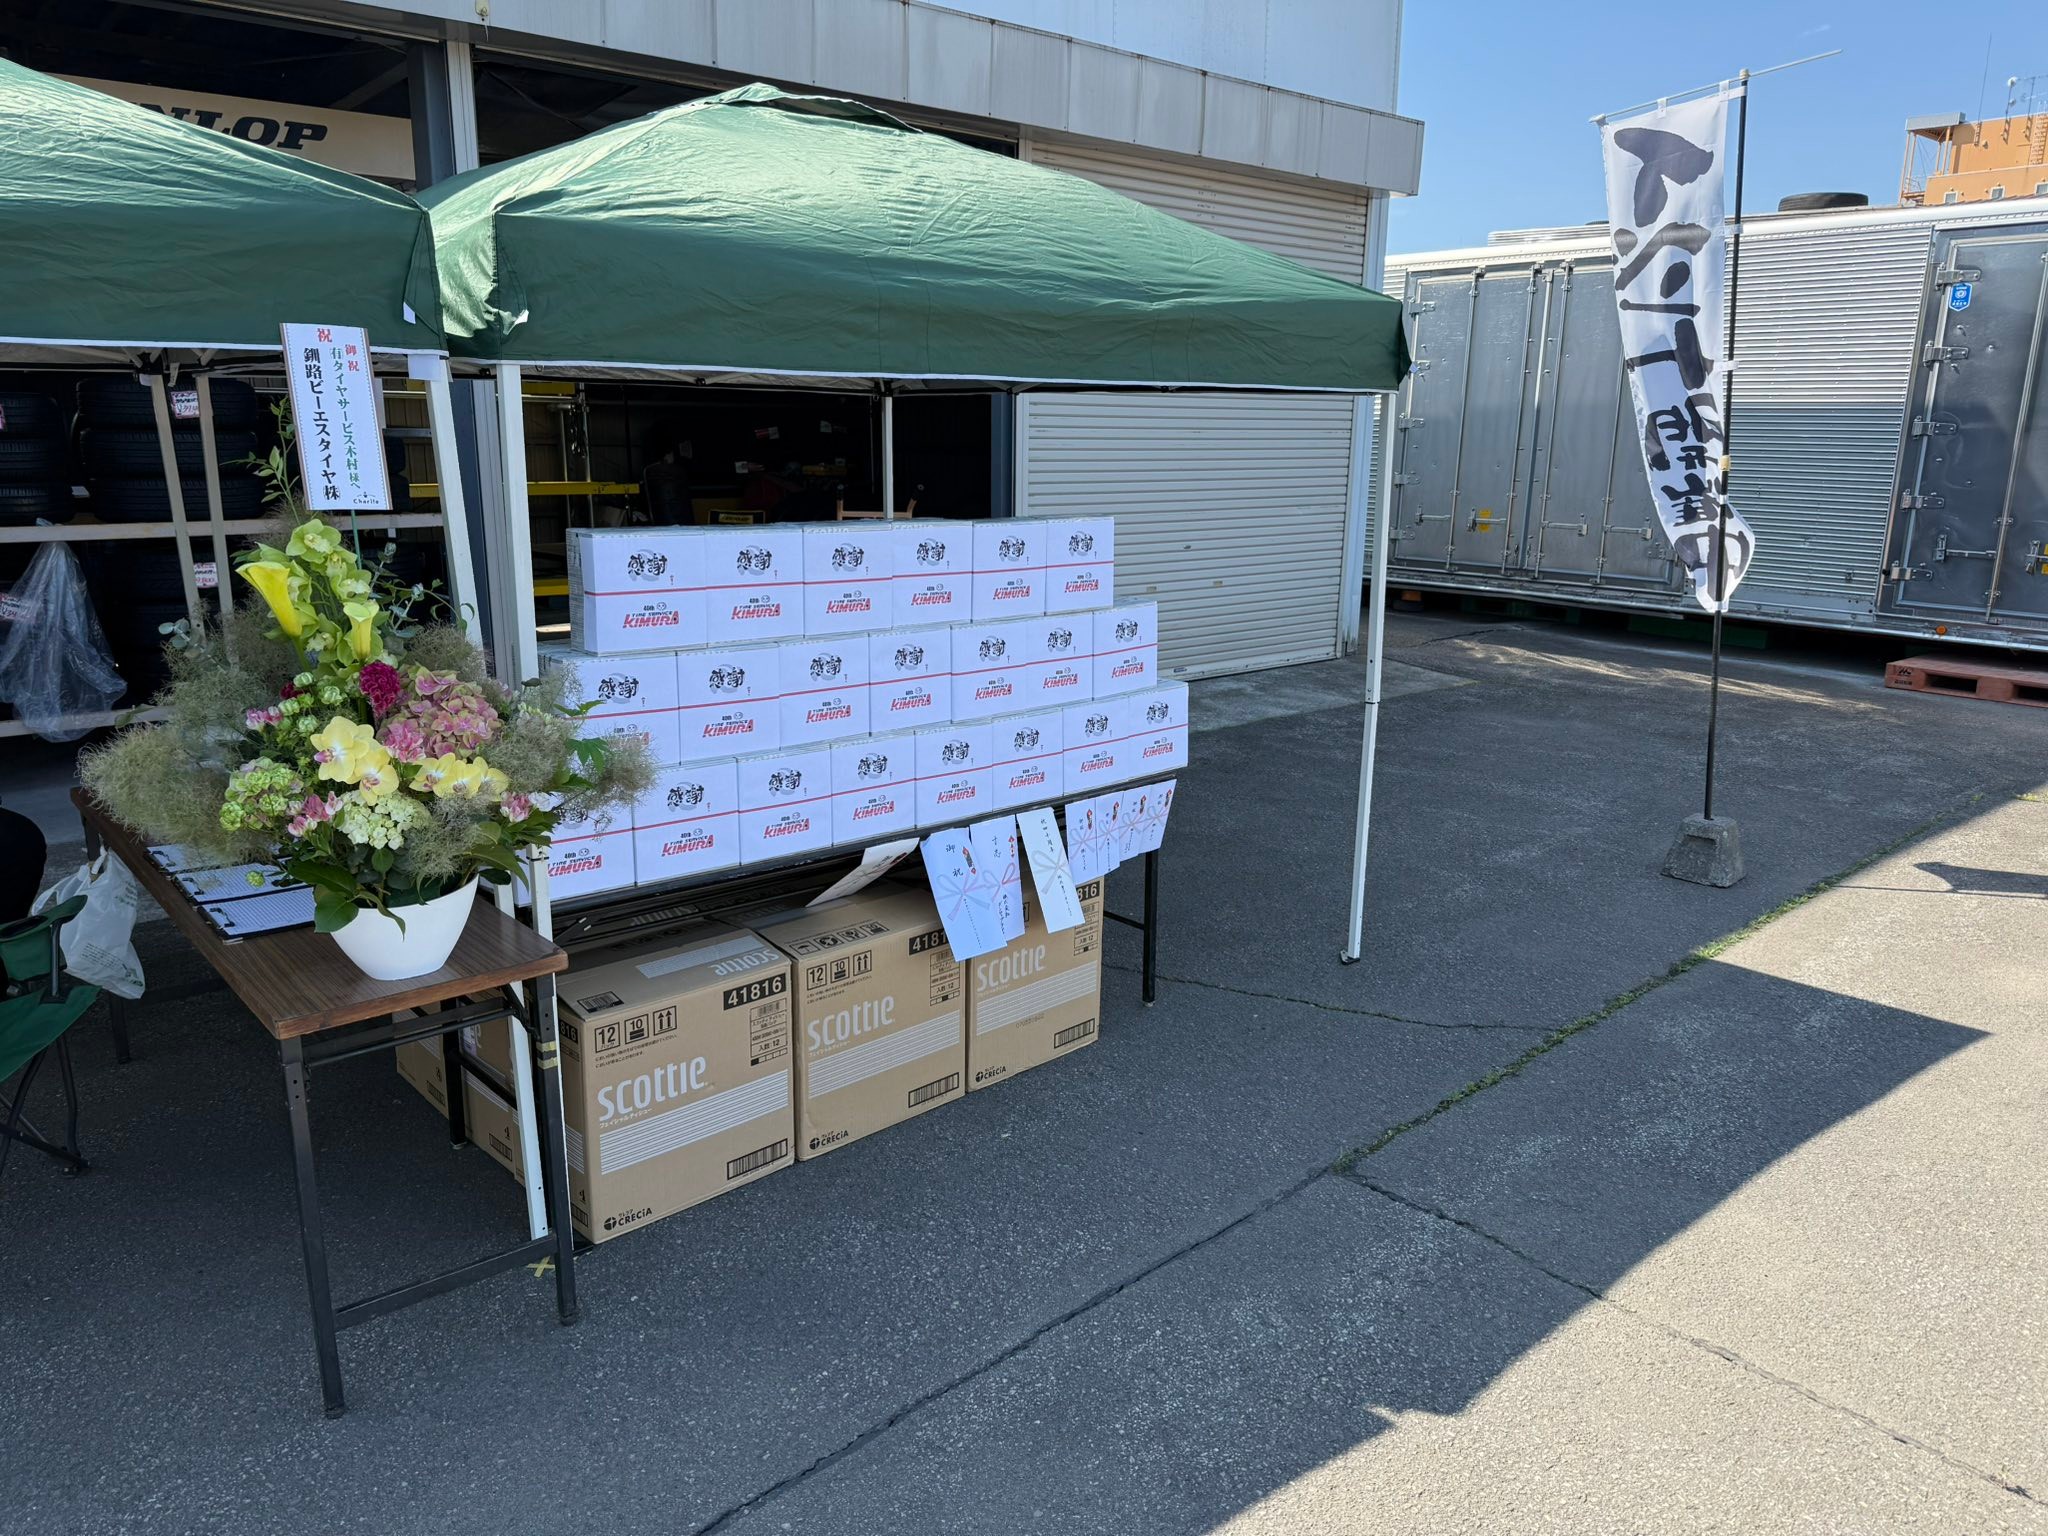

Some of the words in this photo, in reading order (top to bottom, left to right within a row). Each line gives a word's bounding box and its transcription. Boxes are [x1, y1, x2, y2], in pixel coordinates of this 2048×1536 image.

[317, 328, 332, 342] 祝
[911, 591, 952, 606] KIMURA
[993, 586, 1031, 600] KIMURA
[731, 604, 781, 620] KIMURA
[826, 598, 871, 614] KIMURA
[623, 611, 679, 628] KIMURA
[975, 683, 1012, 700] KIMURA
[890, 694, 932, 711] KIMURA
[805, 705, 852, 723] KIMURA
[703, 719, 754, 738] KIMURA
[937, 786, 976, 804] KIMURA
[853, 800, 895, 820] KIMURA
[763, 818, 810, 839] KIMURA
[661, 835, 714, 857] KIMURA
[548, 855, 602, 877] KIMURA
[913, 932, 948, 951] 4181
[835, 961, 845, 970] 10
[809, 968, 824, 983] 12
[728, 976, 782, 1006] 41816
[630, 1018, 643, 1031] 10
[598, 1026, 616, 1044] 12
